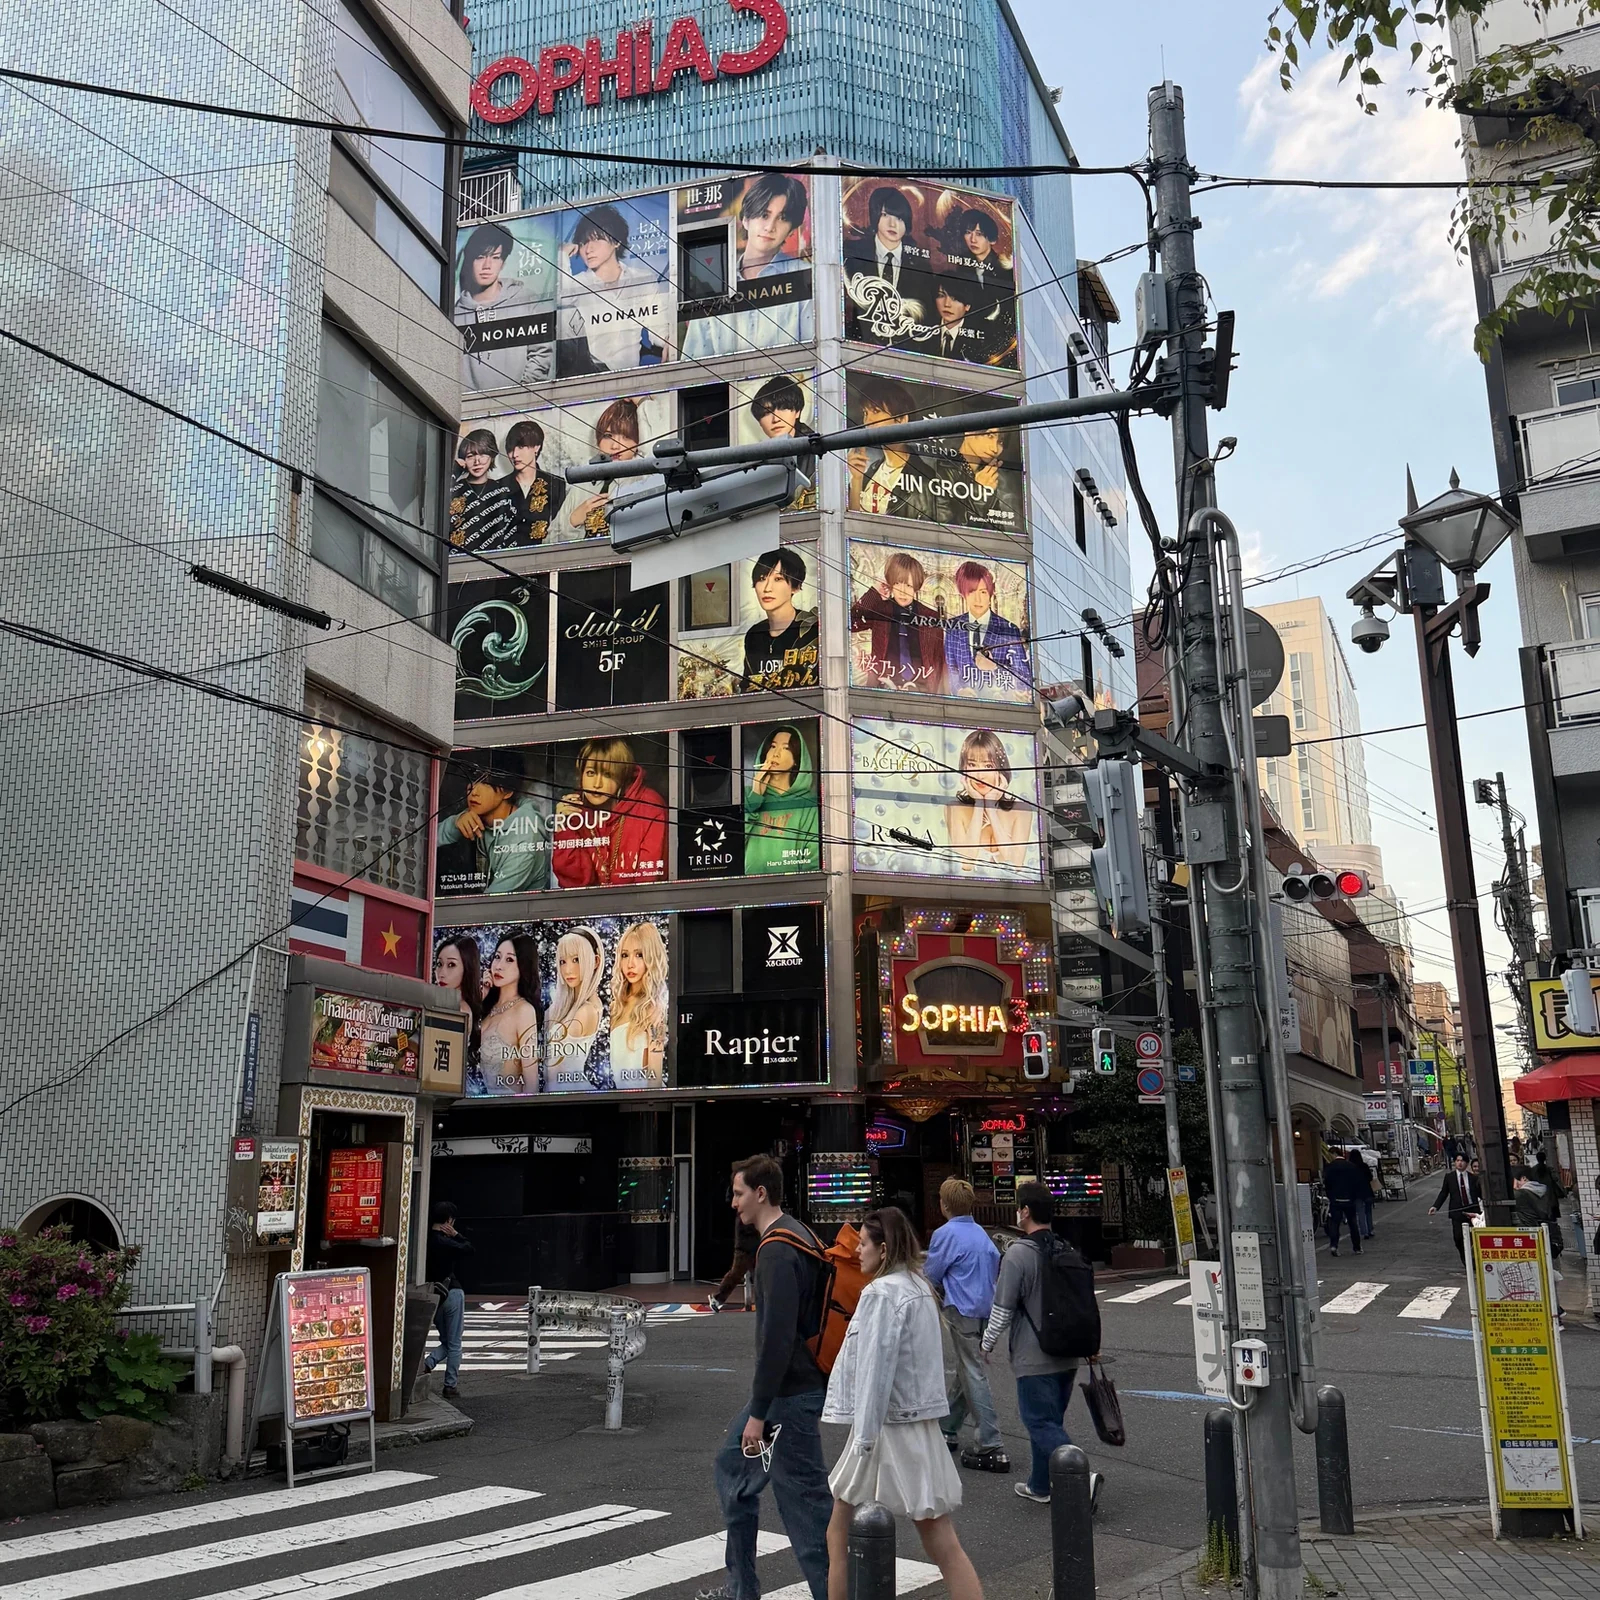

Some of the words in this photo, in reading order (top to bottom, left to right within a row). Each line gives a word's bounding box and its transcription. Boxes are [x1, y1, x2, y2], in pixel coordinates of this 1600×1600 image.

[685, 184, 722, 208] 世那
[685, 203, 722, 214] SENA
[637, 220, 661, 234] 七星
[518, 267, 542, 278] RYO
[591, 304, 660, 326] NONAME
[482, 322, 548, 342] NONAME
[915, 443, 958, 458] TREND
[893, 472, 923, 494] AIN
[928, 479, 995, 503] GROUP
[565, 608, 622, 639] club
[910, 615, 965, 631] ARCANA
[613, 634, 645, 645] GROUP
[598, 650, 626, 673] 5F
[784, 646, 818, 667] 日向
[862, 755, 938, 773] BACHERON
[493, 816, 538, 837] RAIN
[544, 810, 611, 833] GROUP
[688, 853, 733, 866] TREND
[783, 858, 812, 866] Satonaka
[322, 997, 367, 1024] Thailand
[374, 1006, 413, 1031] Vietnam
[681, 1013, 694, 1024] 1F
[902, 994, 1008, 1033] SOPHIA
[1009, 997, 1030, 1033] 3
[344, 1020, 390, 1044] Restaurant
[501, 1042, 588, 1061] BACHERON
[704, 1028, 800, 1065] Rapier
[1142, 1040, 1157, 1052] 30
[434, 1040, 451, 1072] 酒
[496, 1075, 525, 1086] ROA
[557, 1071, 598, 1083] ERENA
[620, 1068, 657, 1080] RUNA
[1481, 1250, 1537, 1259] 放置禁止区域
